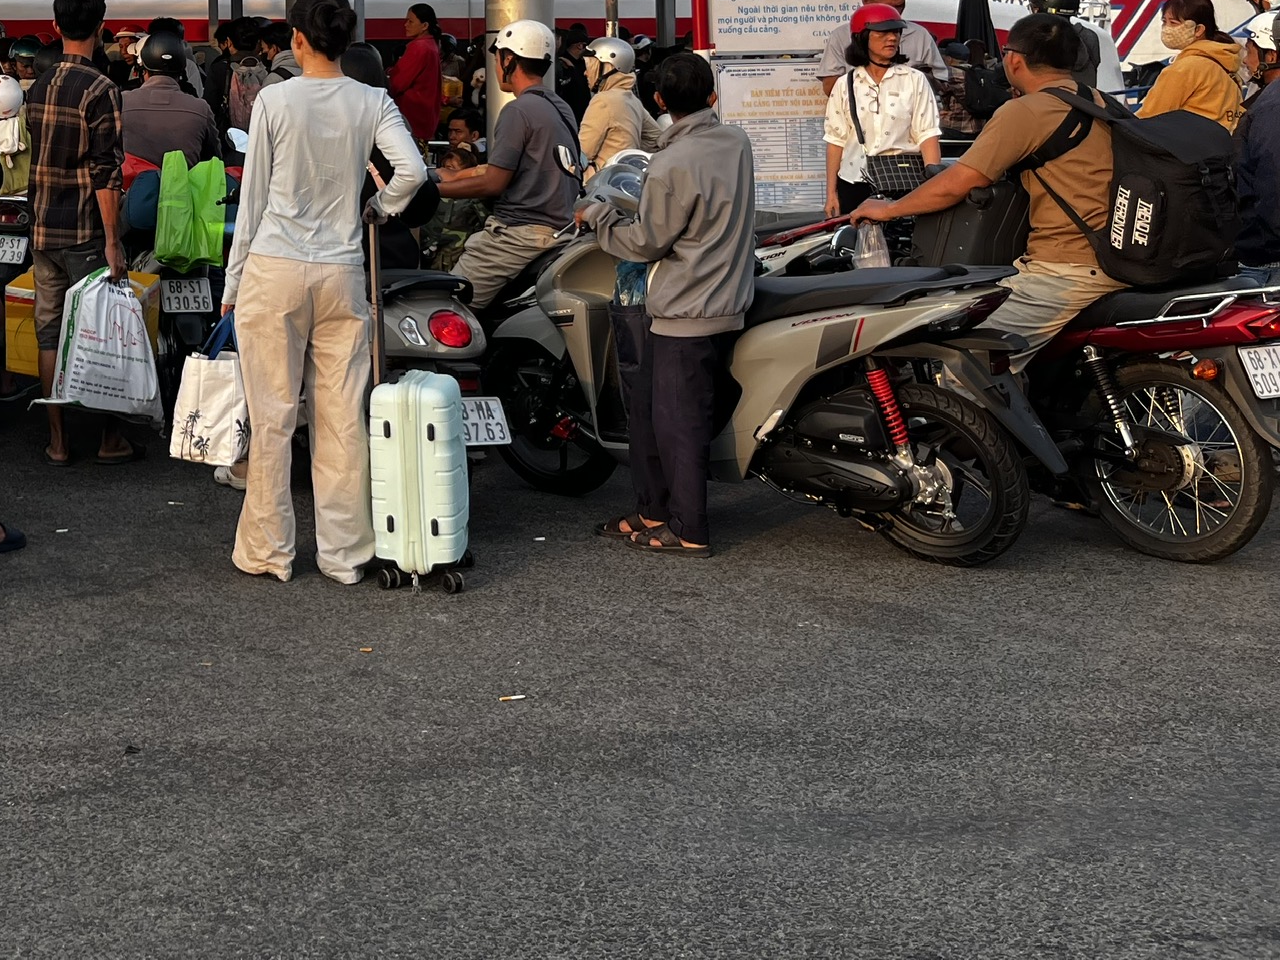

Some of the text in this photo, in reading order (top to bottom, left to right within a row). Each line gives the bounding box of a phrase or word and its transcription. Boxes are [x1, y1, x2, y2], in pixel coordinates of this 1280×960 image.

[738, 5, 761, 16] Ngoài
[763, 4, 778, 13] thời
[781, 4, 798, 15] gian
[801, 4, 816, 13] nêu
[818, 4, 836, 14] trên,
[839, 2, 850, 12] tất
[718, 23, 781, 36] xuống cầu cảng.
[166, 296, 210, 311] 130.56
[1252, 371, 1280, 395] 509
[461, 401, 495, 420] 8-MA
[463, 422, 506, 441] 97.63
